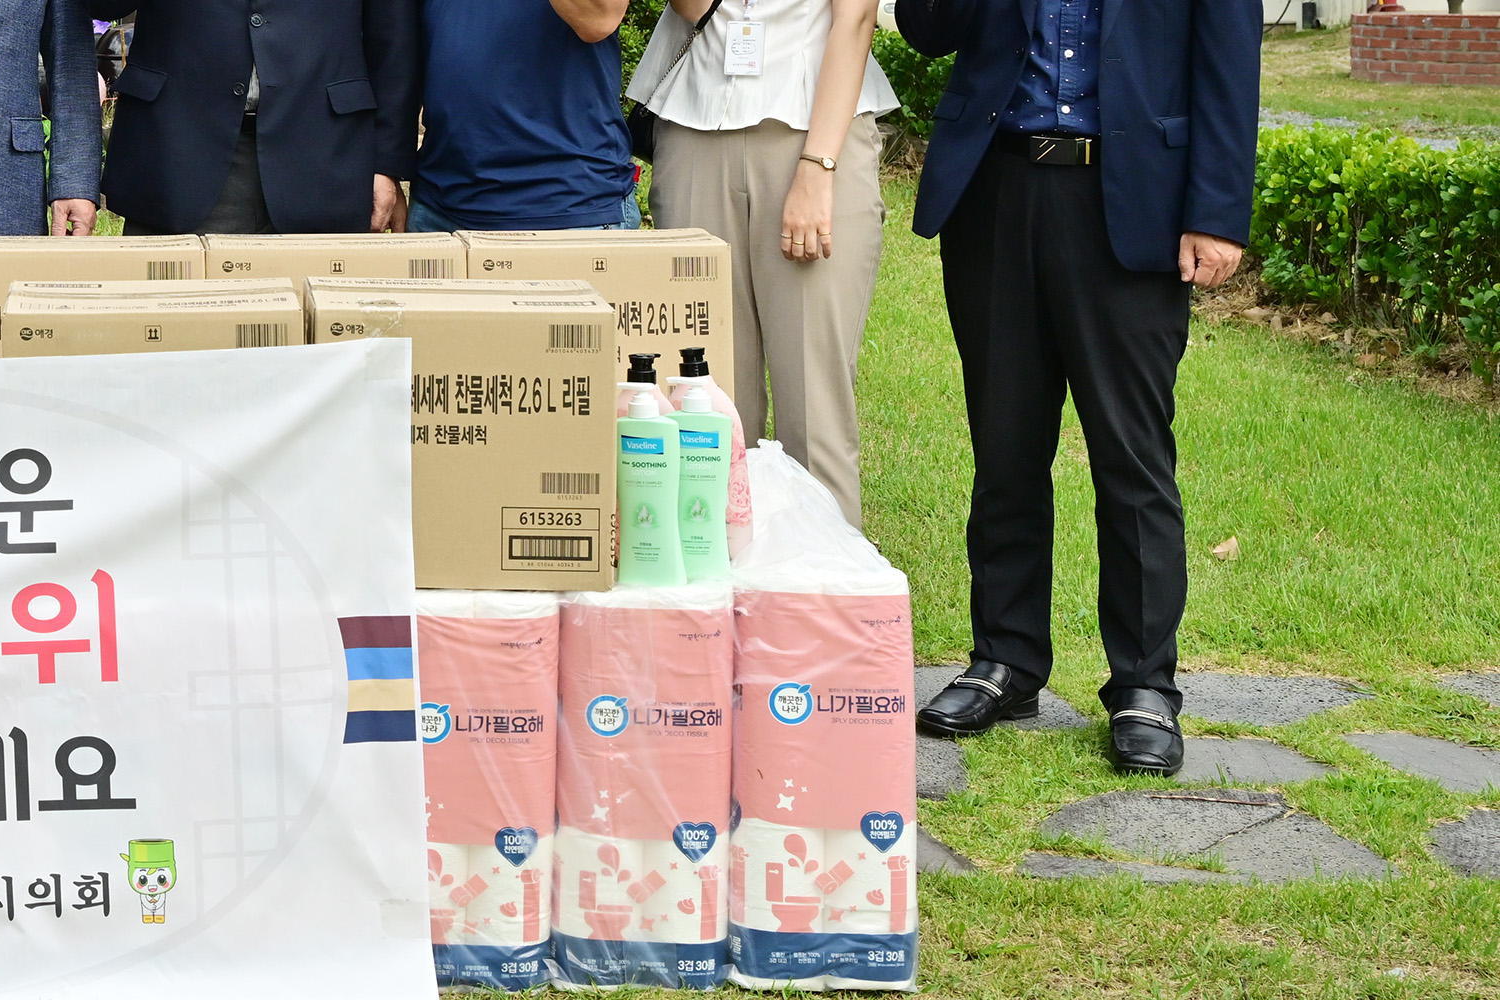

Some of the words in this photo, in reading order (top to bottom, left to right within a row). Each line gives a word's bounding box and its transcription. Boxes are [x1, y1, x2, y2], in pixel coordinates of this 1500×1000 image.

[235, 261, 251, 271] 애경
[496, 260, 513, 269] 애경
[610, 301, 643, 336] 세척
[647, 303, 668, 336] 2.6
[672, 303, 681, 334] L
[685, 301, 709, 336] 리필
[34, 329, 53, 338] 애경
[345, 324, 364, 334] 애경
[455, 374, 513, 415] 찬물세척
[518, 377, 542, 414] 2.6
[547, 378, 556, 413] L
[563, 376, 590, 415] 리필
[411, 425, 429, 445] 제
[435, 425, 487, 445] 찬물세척
[681, 435, 713, 443] Vaseline
[626, 441, 657, 450] Vaseline
[519, 512, 582, 526] 6153263
[778, 695, 803, 705] 깨끗한
[817, 695, 905, 714] 니가필요해
[595, 708, 619, 718] 깨끗한
[782, 705, 799, 714] 나라
[598, 717, 616, 726] 나라
[633, 708, 722, 727] 니가필요해
[422, 725, 438, 733] 나라
[455, 715, 544, 733] 니가필요해
[869, 819, 897, 830] 100%
[503, 835, 529, 845] 100%
[682, 830, 709, 840] 100%
[868, 951, 884, 962] 3겹
[886, 950, 905, 962] 30롤
[501, 962, 517, 973] 3겹
[519, 960, 539, 973] 30롤
[677, 960, 694, 971] 3겹
[695, 959, 715, 971] 30롤
